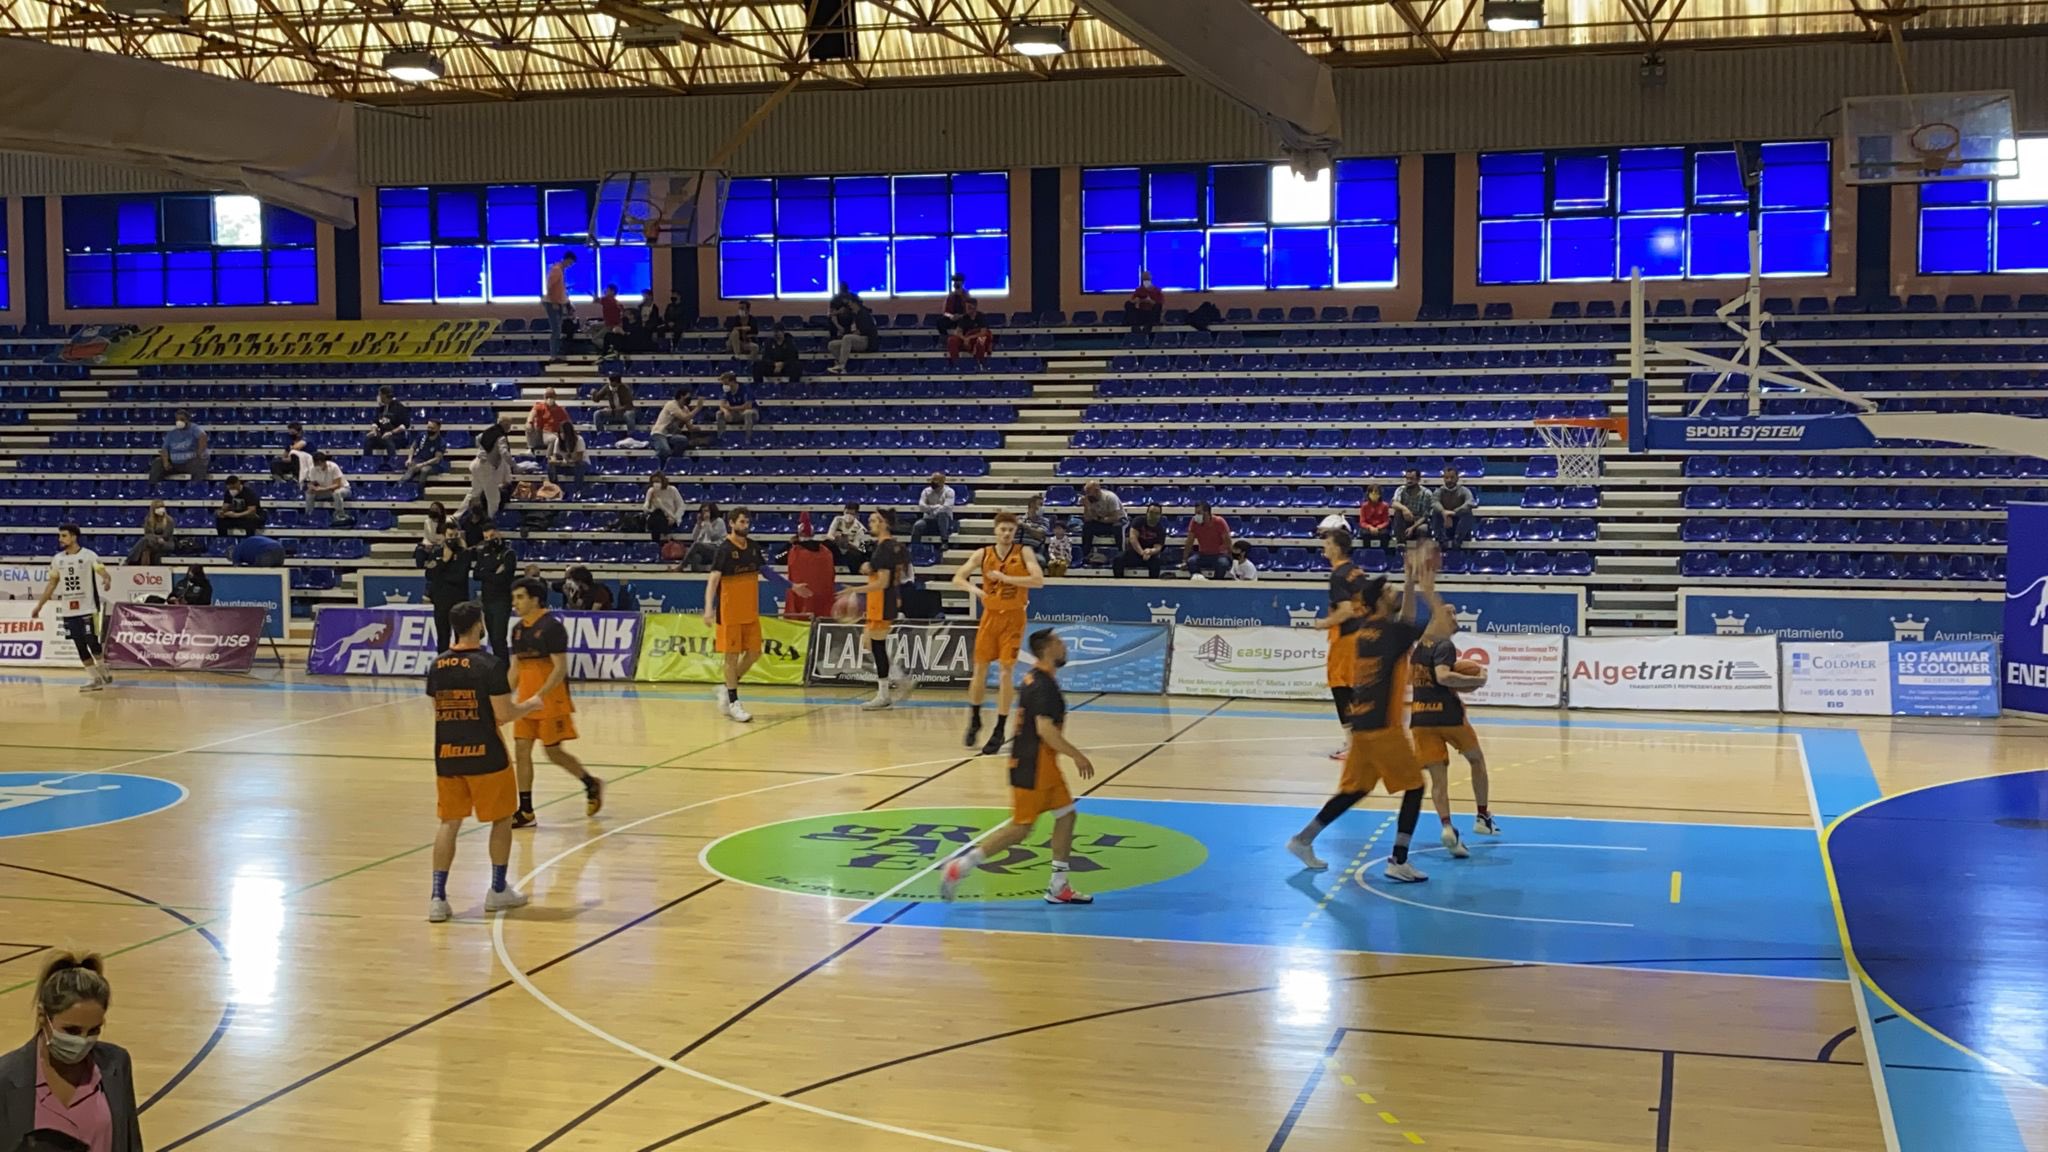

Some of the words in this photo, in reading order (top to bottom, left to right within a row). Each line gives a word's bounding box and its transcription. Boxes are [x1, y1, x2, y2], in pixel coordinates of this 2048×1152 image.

[1686, 425, 1739, 437] SPORT
[1740, 425, 1805, 440] SYSTEM
[68, 567, 75, 575] 9
[146, 573, 163, 585] ice
[1033, 611, 1109, 623] Ayuntamiento
[1184, 615, 1262, 627] Ayuntamiento
[1486, 621, 1571, 634] Ayuntamiento
[1755, 626, 1844, 640] Ayuntamiento
[115, 629, 250, 647] masterhouse
[1237, 648, 1326, 660] easysports
[1898, 652, 1917, 662] LO
[1920, 652, 1990, 663] FAMILIAR
[1812, 656, 1877, 669] COLOMER
[1899, 663, 1915, 673] ES
[1918, 663, 1990, 674] COLOMER
[1573, 660, 1735, 685] Algetransit
